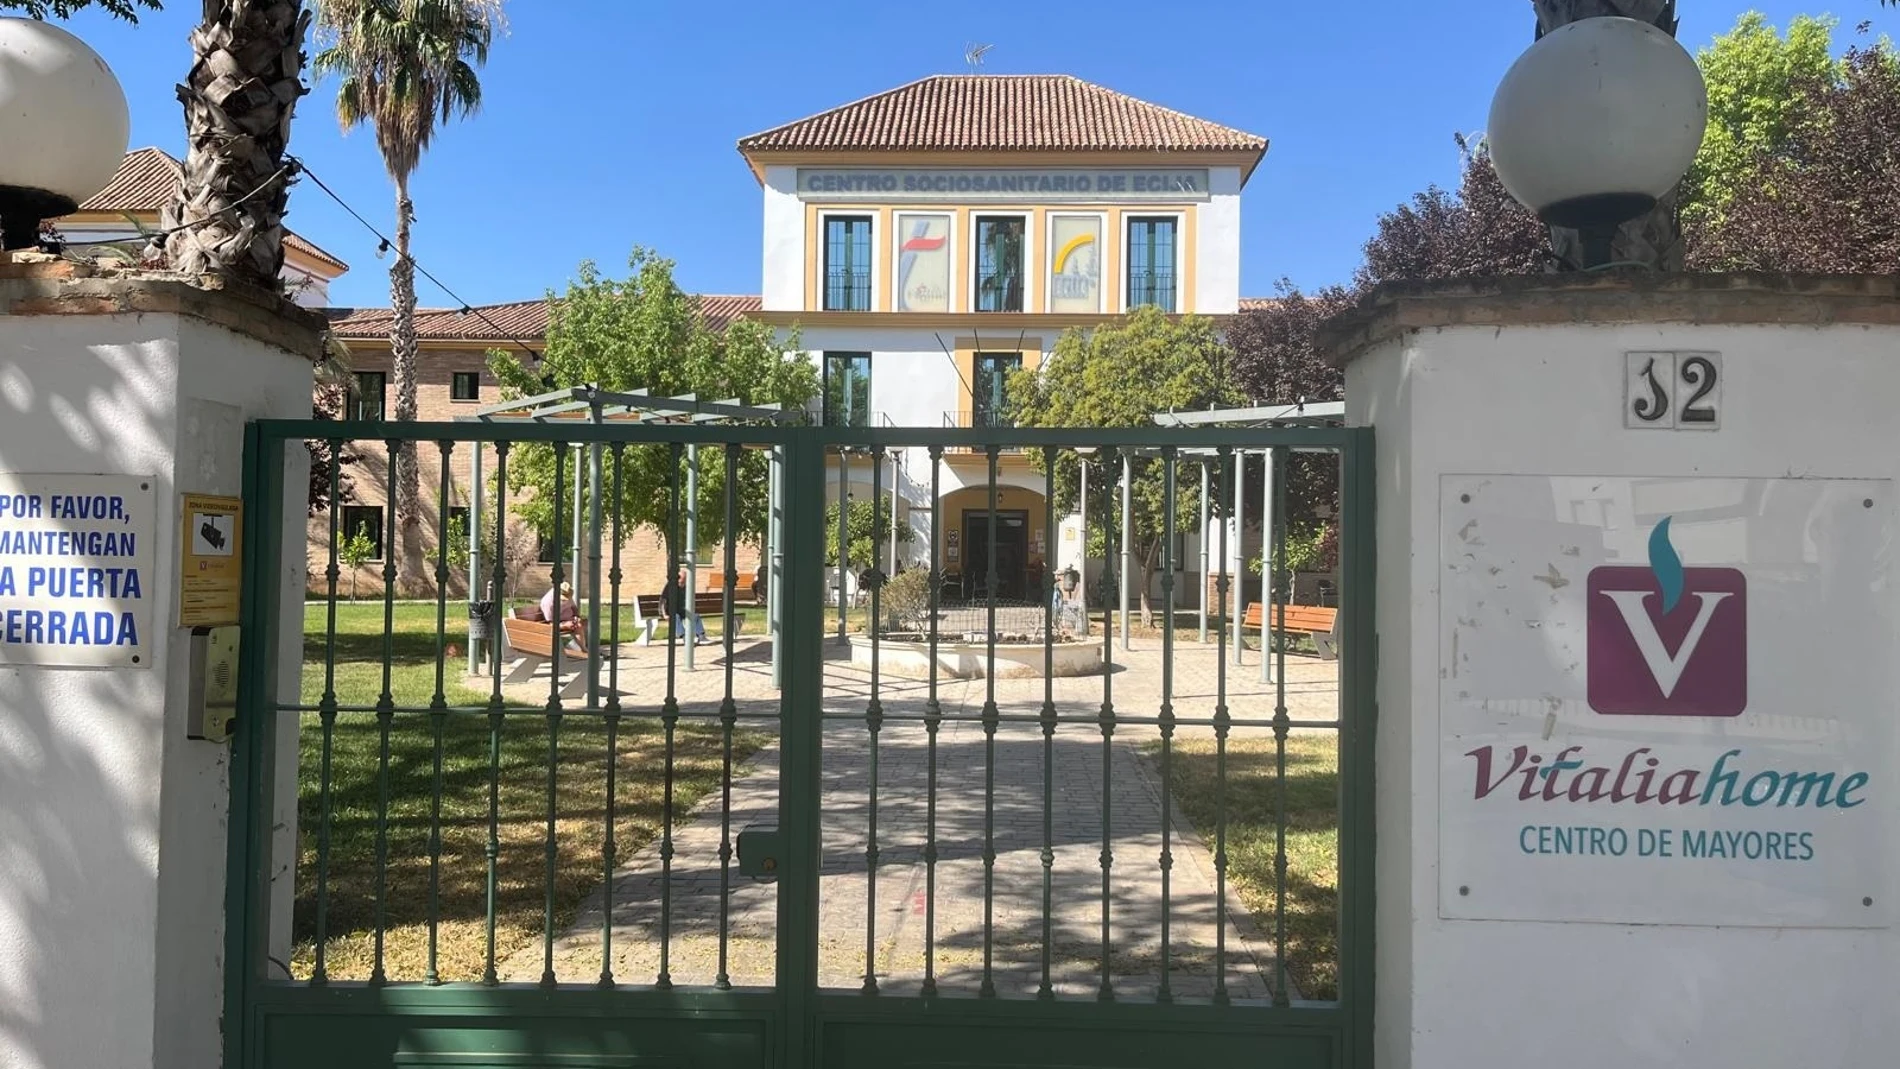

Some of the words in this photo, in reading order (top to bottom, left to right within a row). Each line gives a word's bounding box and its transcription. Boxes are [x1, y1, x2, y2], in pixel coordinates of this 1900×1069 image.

[807, 174, 898, 192] CENTRO
[903, 174, 1092, 192] SOCIOSANITARIO
[1097, 174, 1125, 192] DE
[1633, 356, 1717, 422] 12
[0, 494, 42, 519] POR
[50, 495, 131, 525] FAVOR,
[0, 566, 16, 597] A
[28, 566, 142, 599] PUERTA
[0, 609, 139, 646] ERRADA
[1598, 588, 1735, 700] V
[1463, 744, 1869, 809] Vitaliahome
[1519, 824, 1628, 856] CENTRO
[1637, 828, 1673, 857] DE
[1682, 829, 1814, 861] MAYORES
